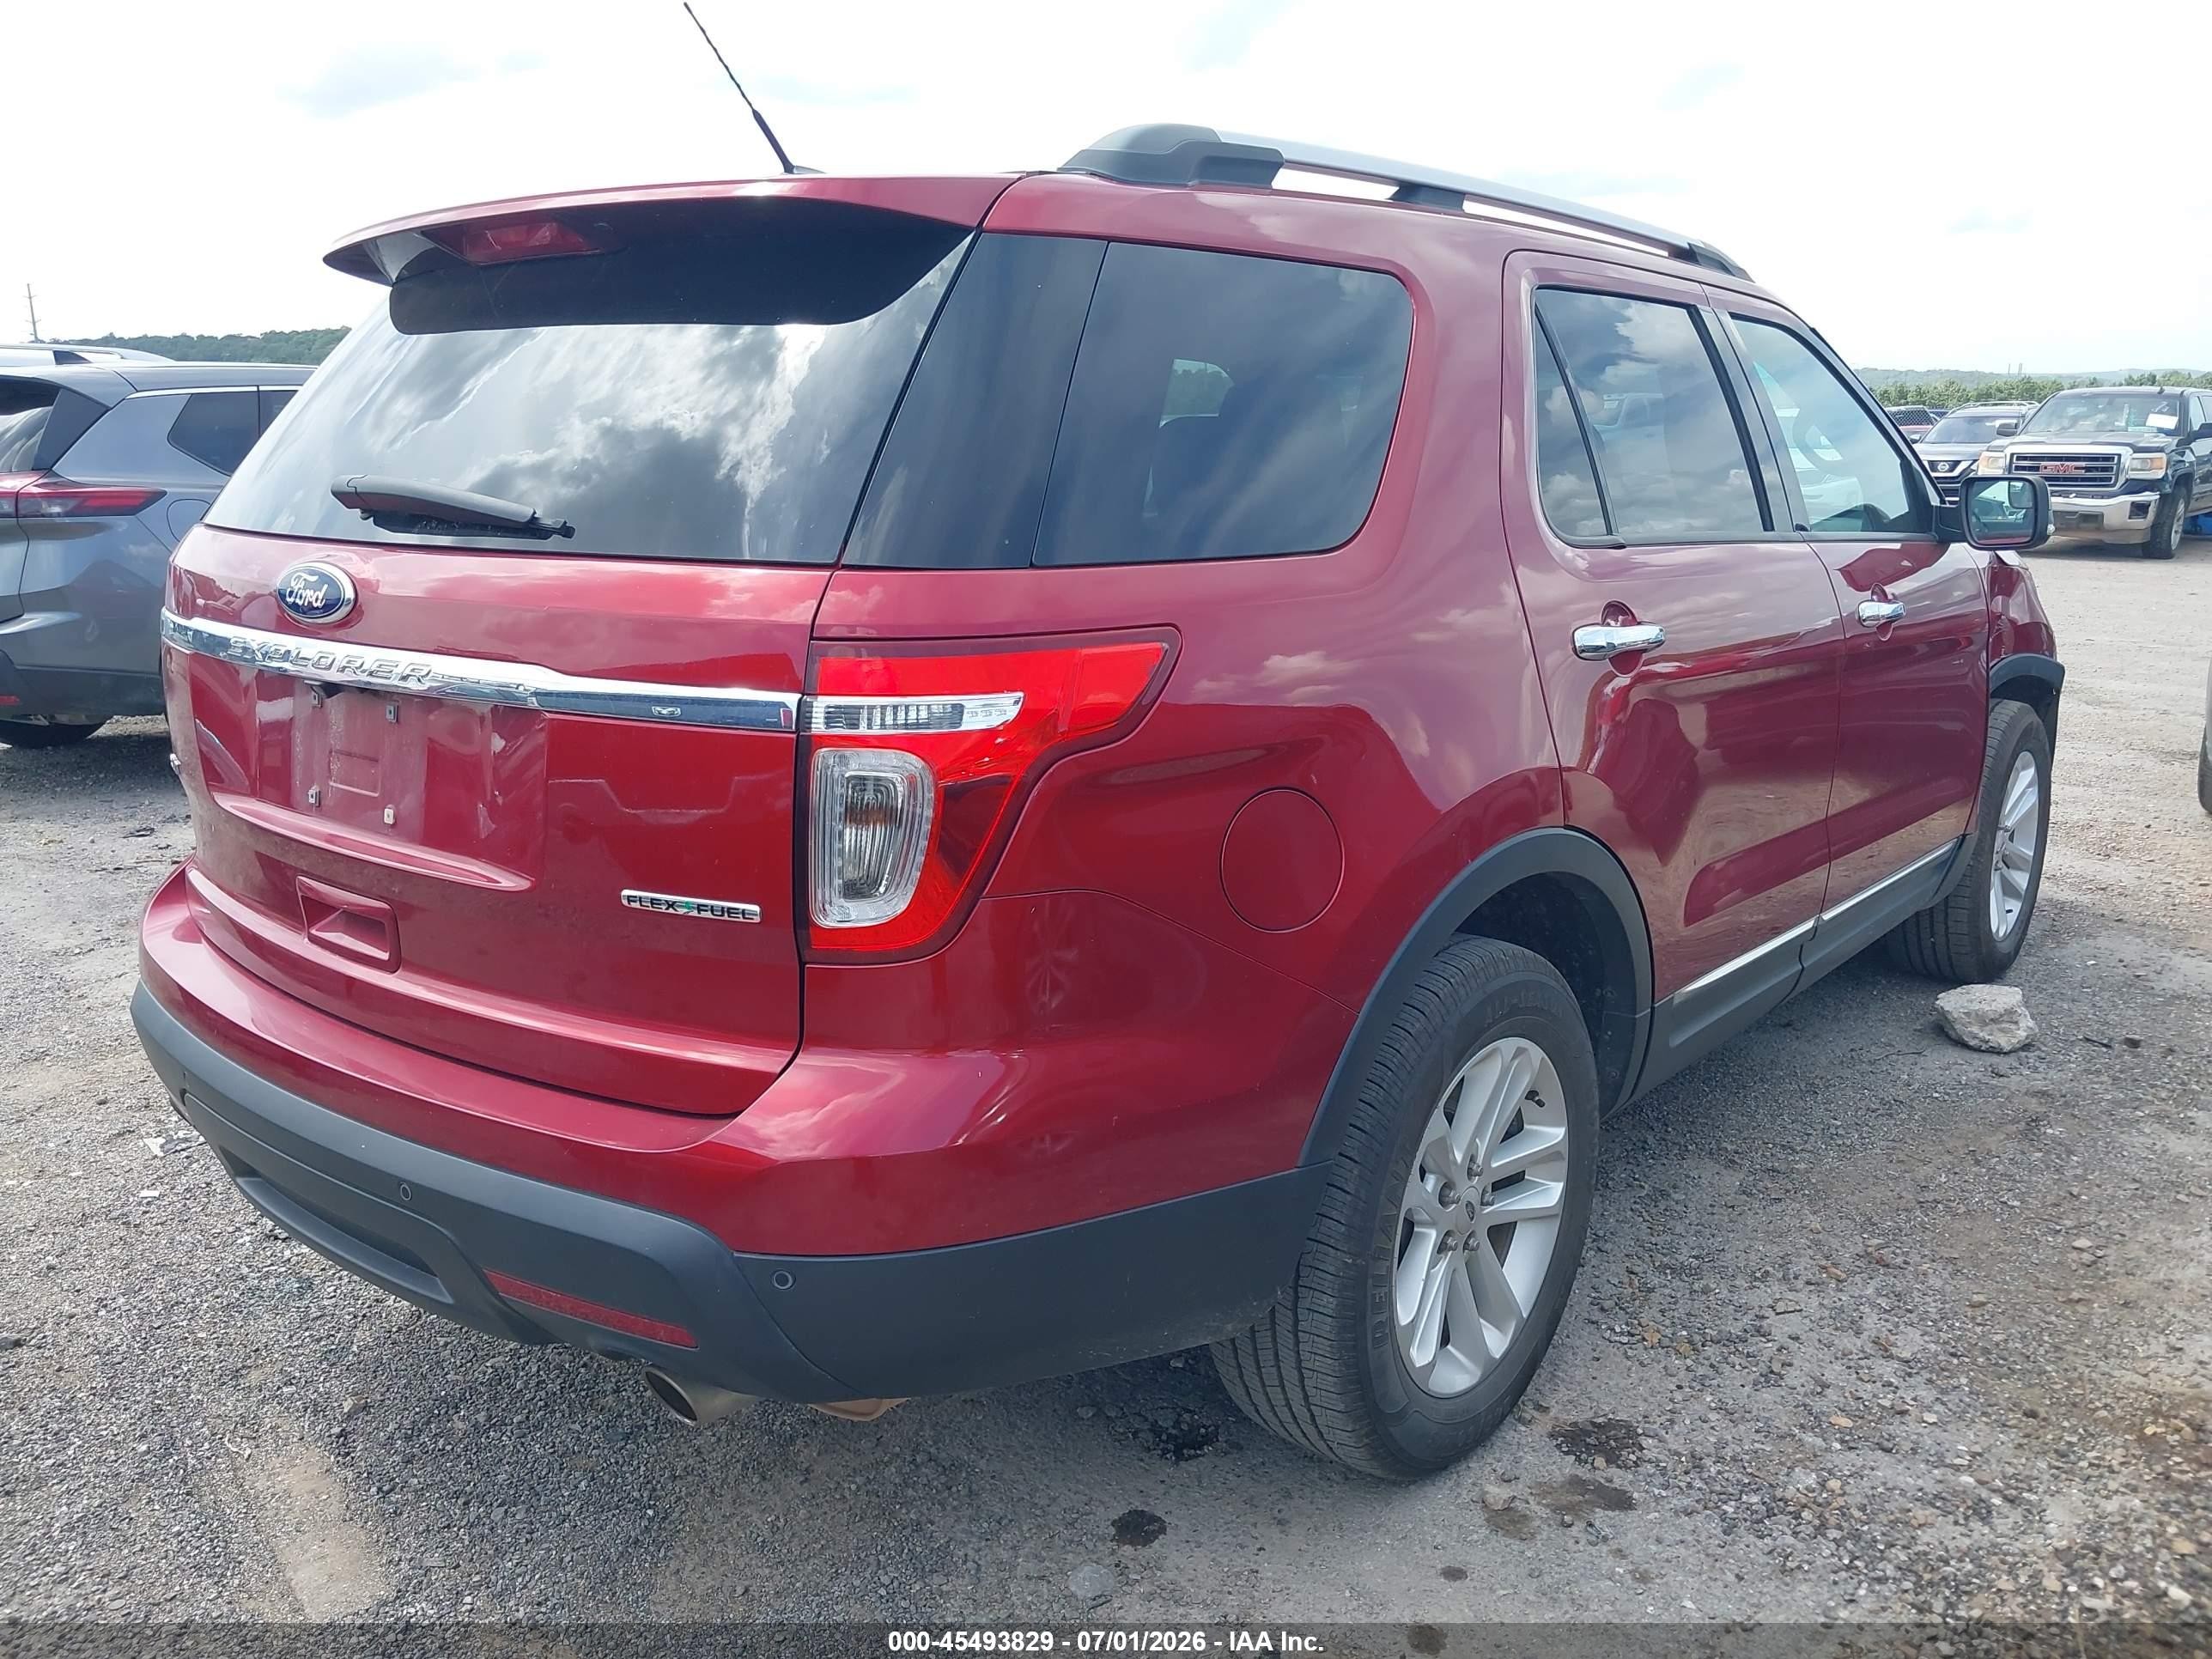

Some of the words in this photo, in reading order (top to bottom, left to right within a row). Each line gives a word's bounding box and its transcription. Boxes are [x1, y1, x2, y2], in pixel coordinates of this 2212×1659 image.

[2039, 462, 2086, 474] GMC
[285, 572, 329, 609] Ford
[227, 635, 432, 689] EXPLORER
[627, 895, 678, 912] FLEX
[696, 903, 757, 921] FUEL
